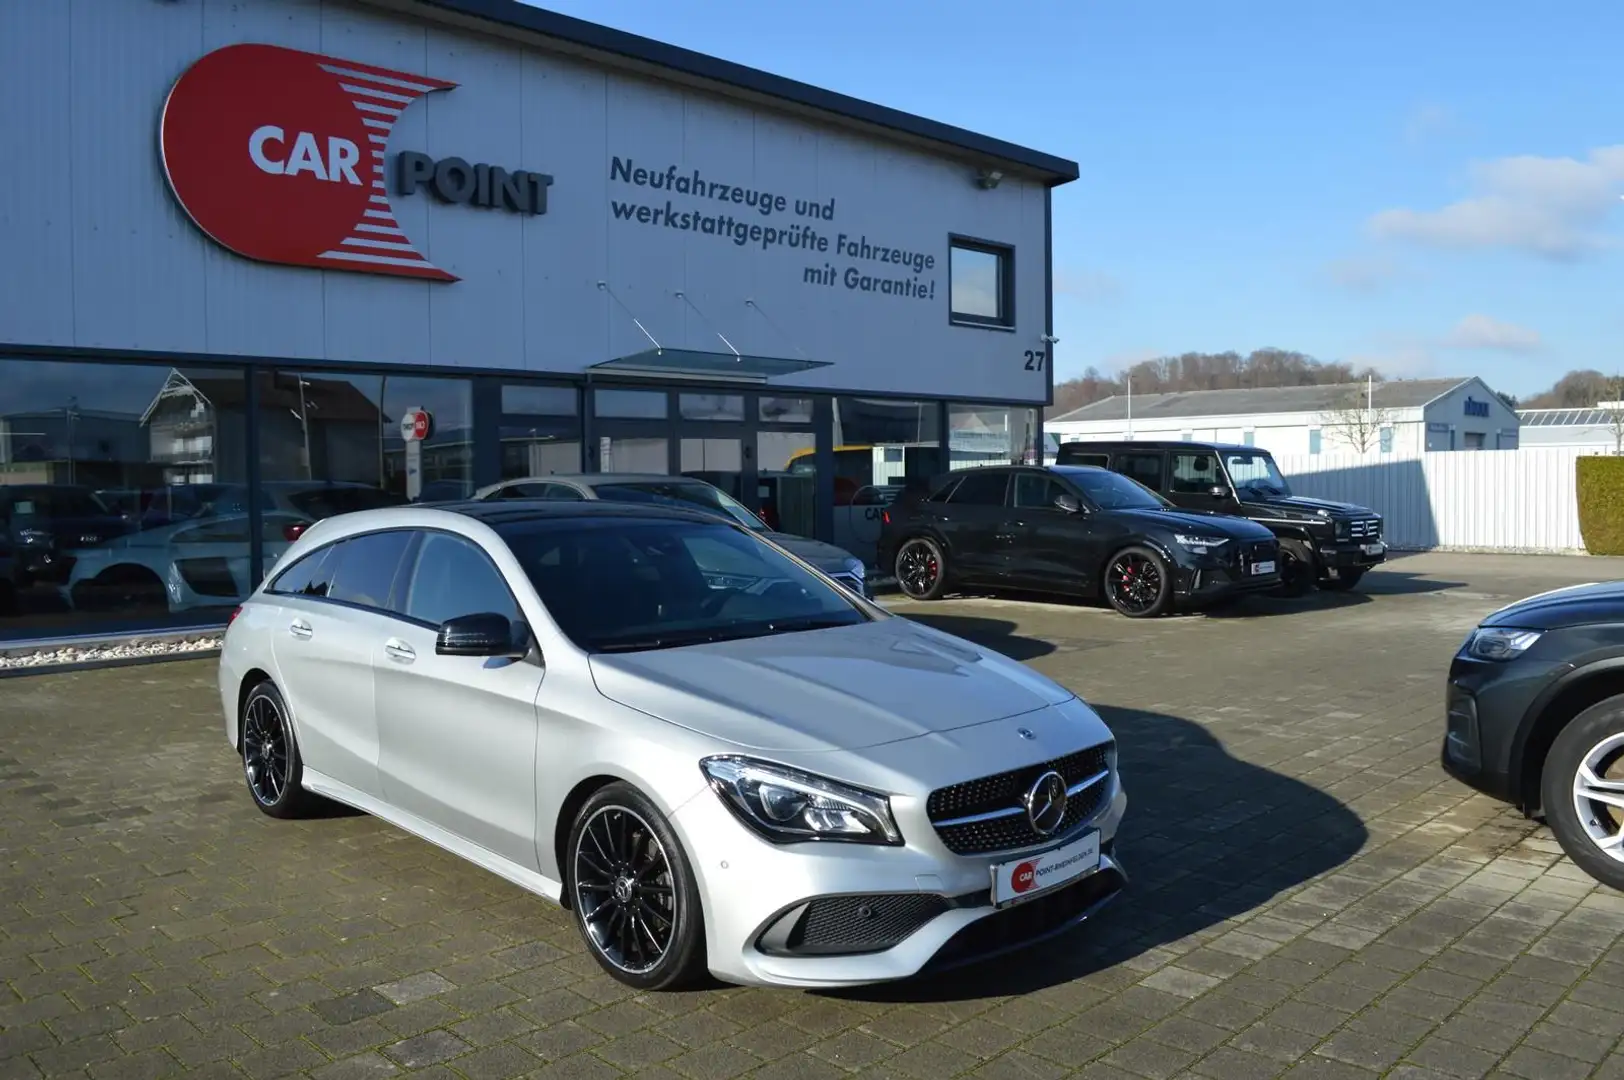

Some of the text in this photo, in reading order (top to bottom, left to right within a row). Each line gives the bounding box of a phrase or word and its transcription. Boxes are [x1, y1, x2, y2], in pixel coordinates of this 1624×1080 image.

[248, 125, 554, 215] CAR POINT
[609, 156, 836, 221] Neufahrzeuge und
[611, 200, 936, 273] werkstattgeprüfte Fahrzeuge
[803, 264, 936, 300] mit Garantie!
[1024, 350, 1045, 371] 27
[1019, 871, 1033, 882] CAR
